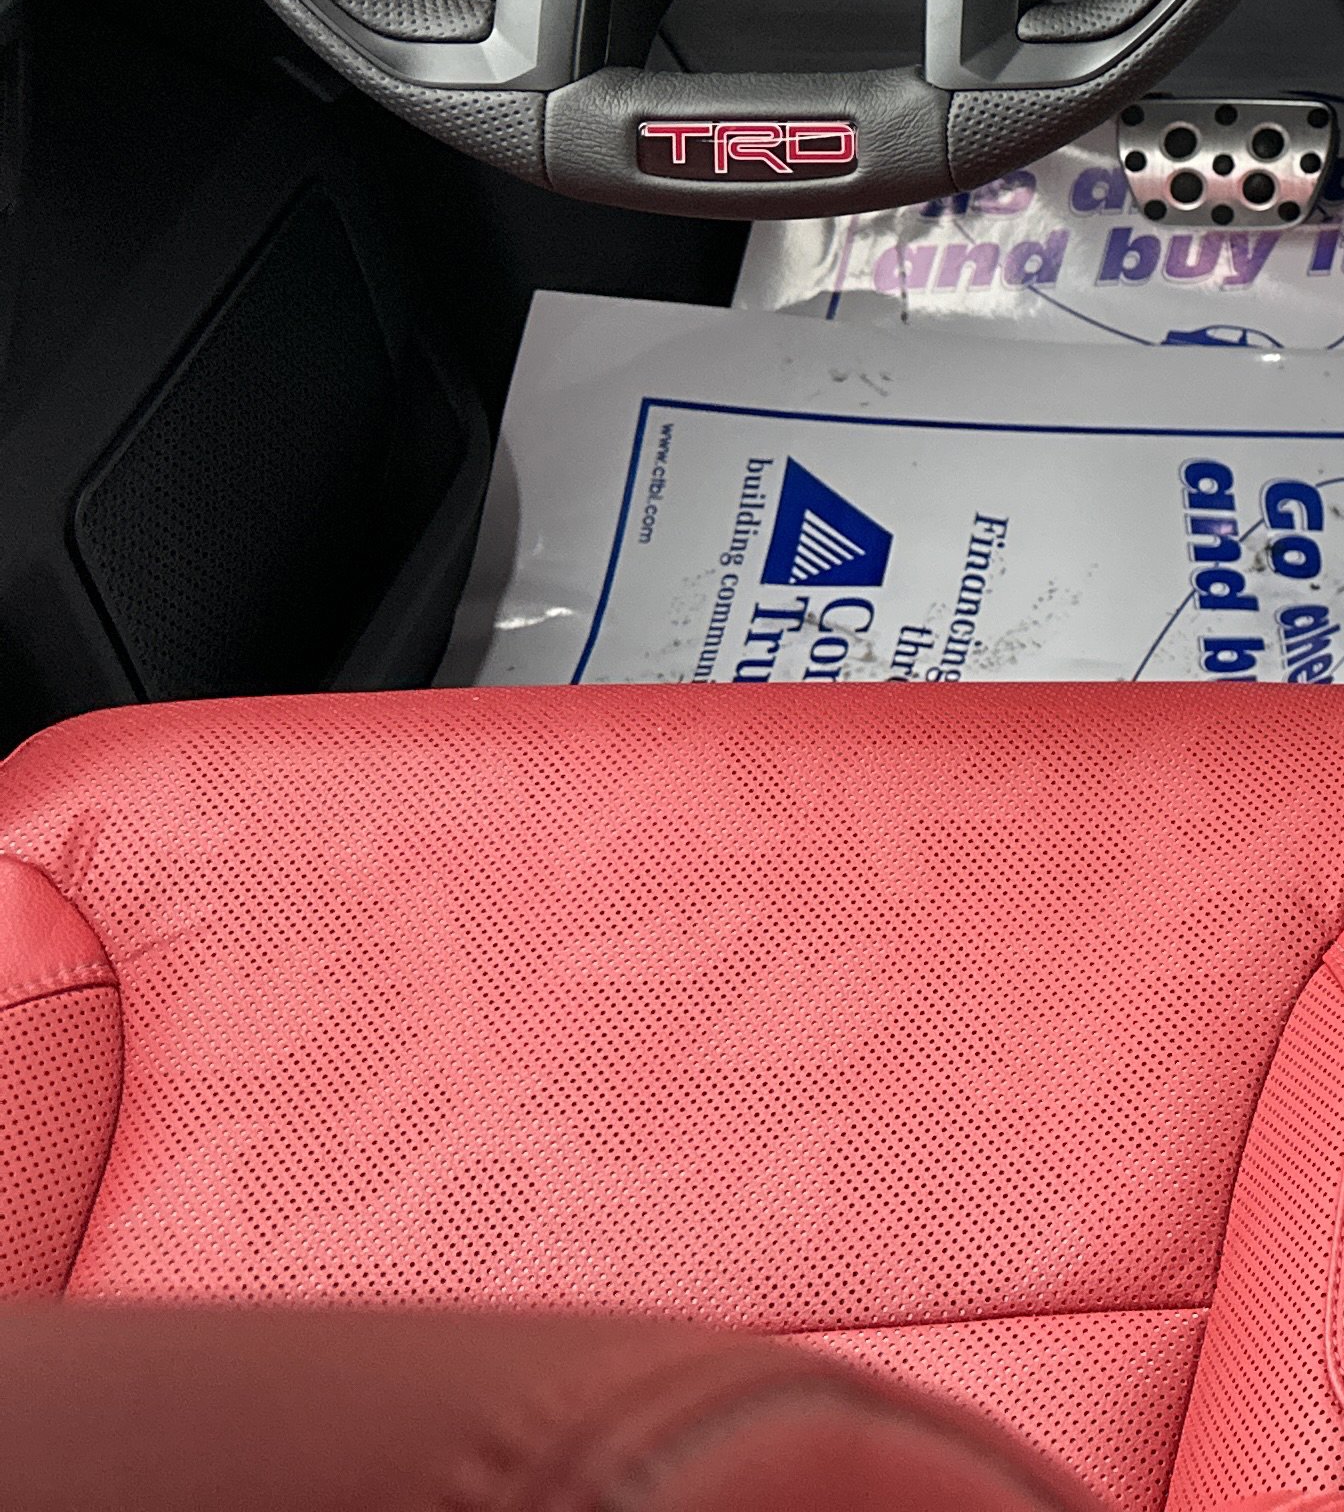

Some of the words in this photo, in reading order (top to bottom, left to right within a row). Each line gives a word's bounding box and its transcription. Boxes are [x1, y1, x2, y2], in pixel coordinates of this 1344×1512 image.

[644, 123, 856, 174] TRD
[871, 226, 1070, 294] and
[1097, 226, 1284, 292] buy
[719, 456, 775, 568] building
[1178, 457, 1260, 613] and
[1262, 476, 1326, 580] Go
[923, 510, 1011, 684] Financing
[1274, 603, 1342, 685] ahe
